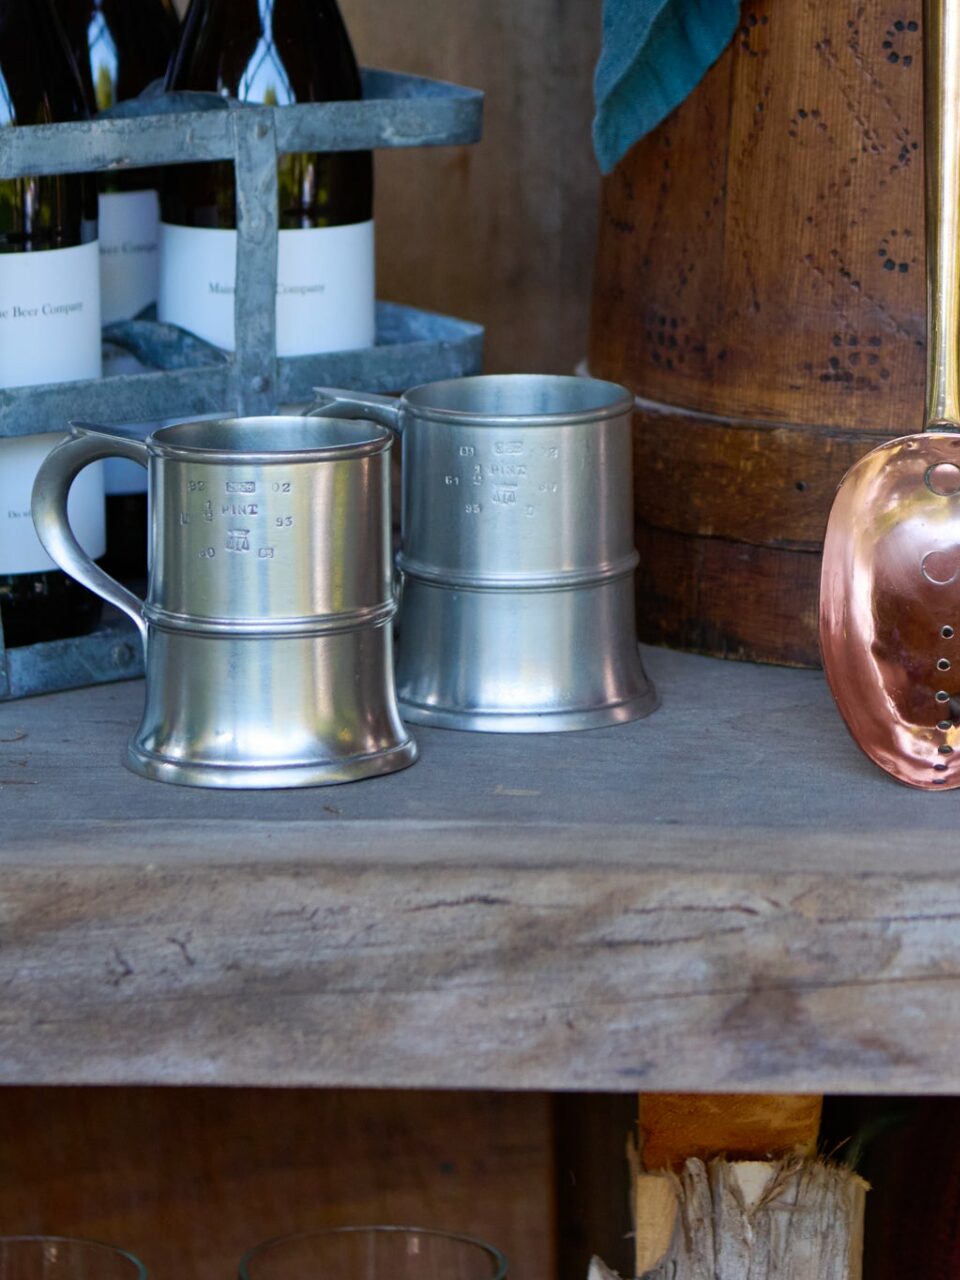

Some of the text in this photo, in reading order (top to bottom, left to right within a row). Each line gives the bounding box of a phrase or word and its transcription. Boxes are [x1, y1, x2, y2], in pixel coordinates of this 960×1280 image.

[13, 306, 38, 319] Beer
[41, 302, 83, 317] Company
[220, 503, 258, 516] PINT
